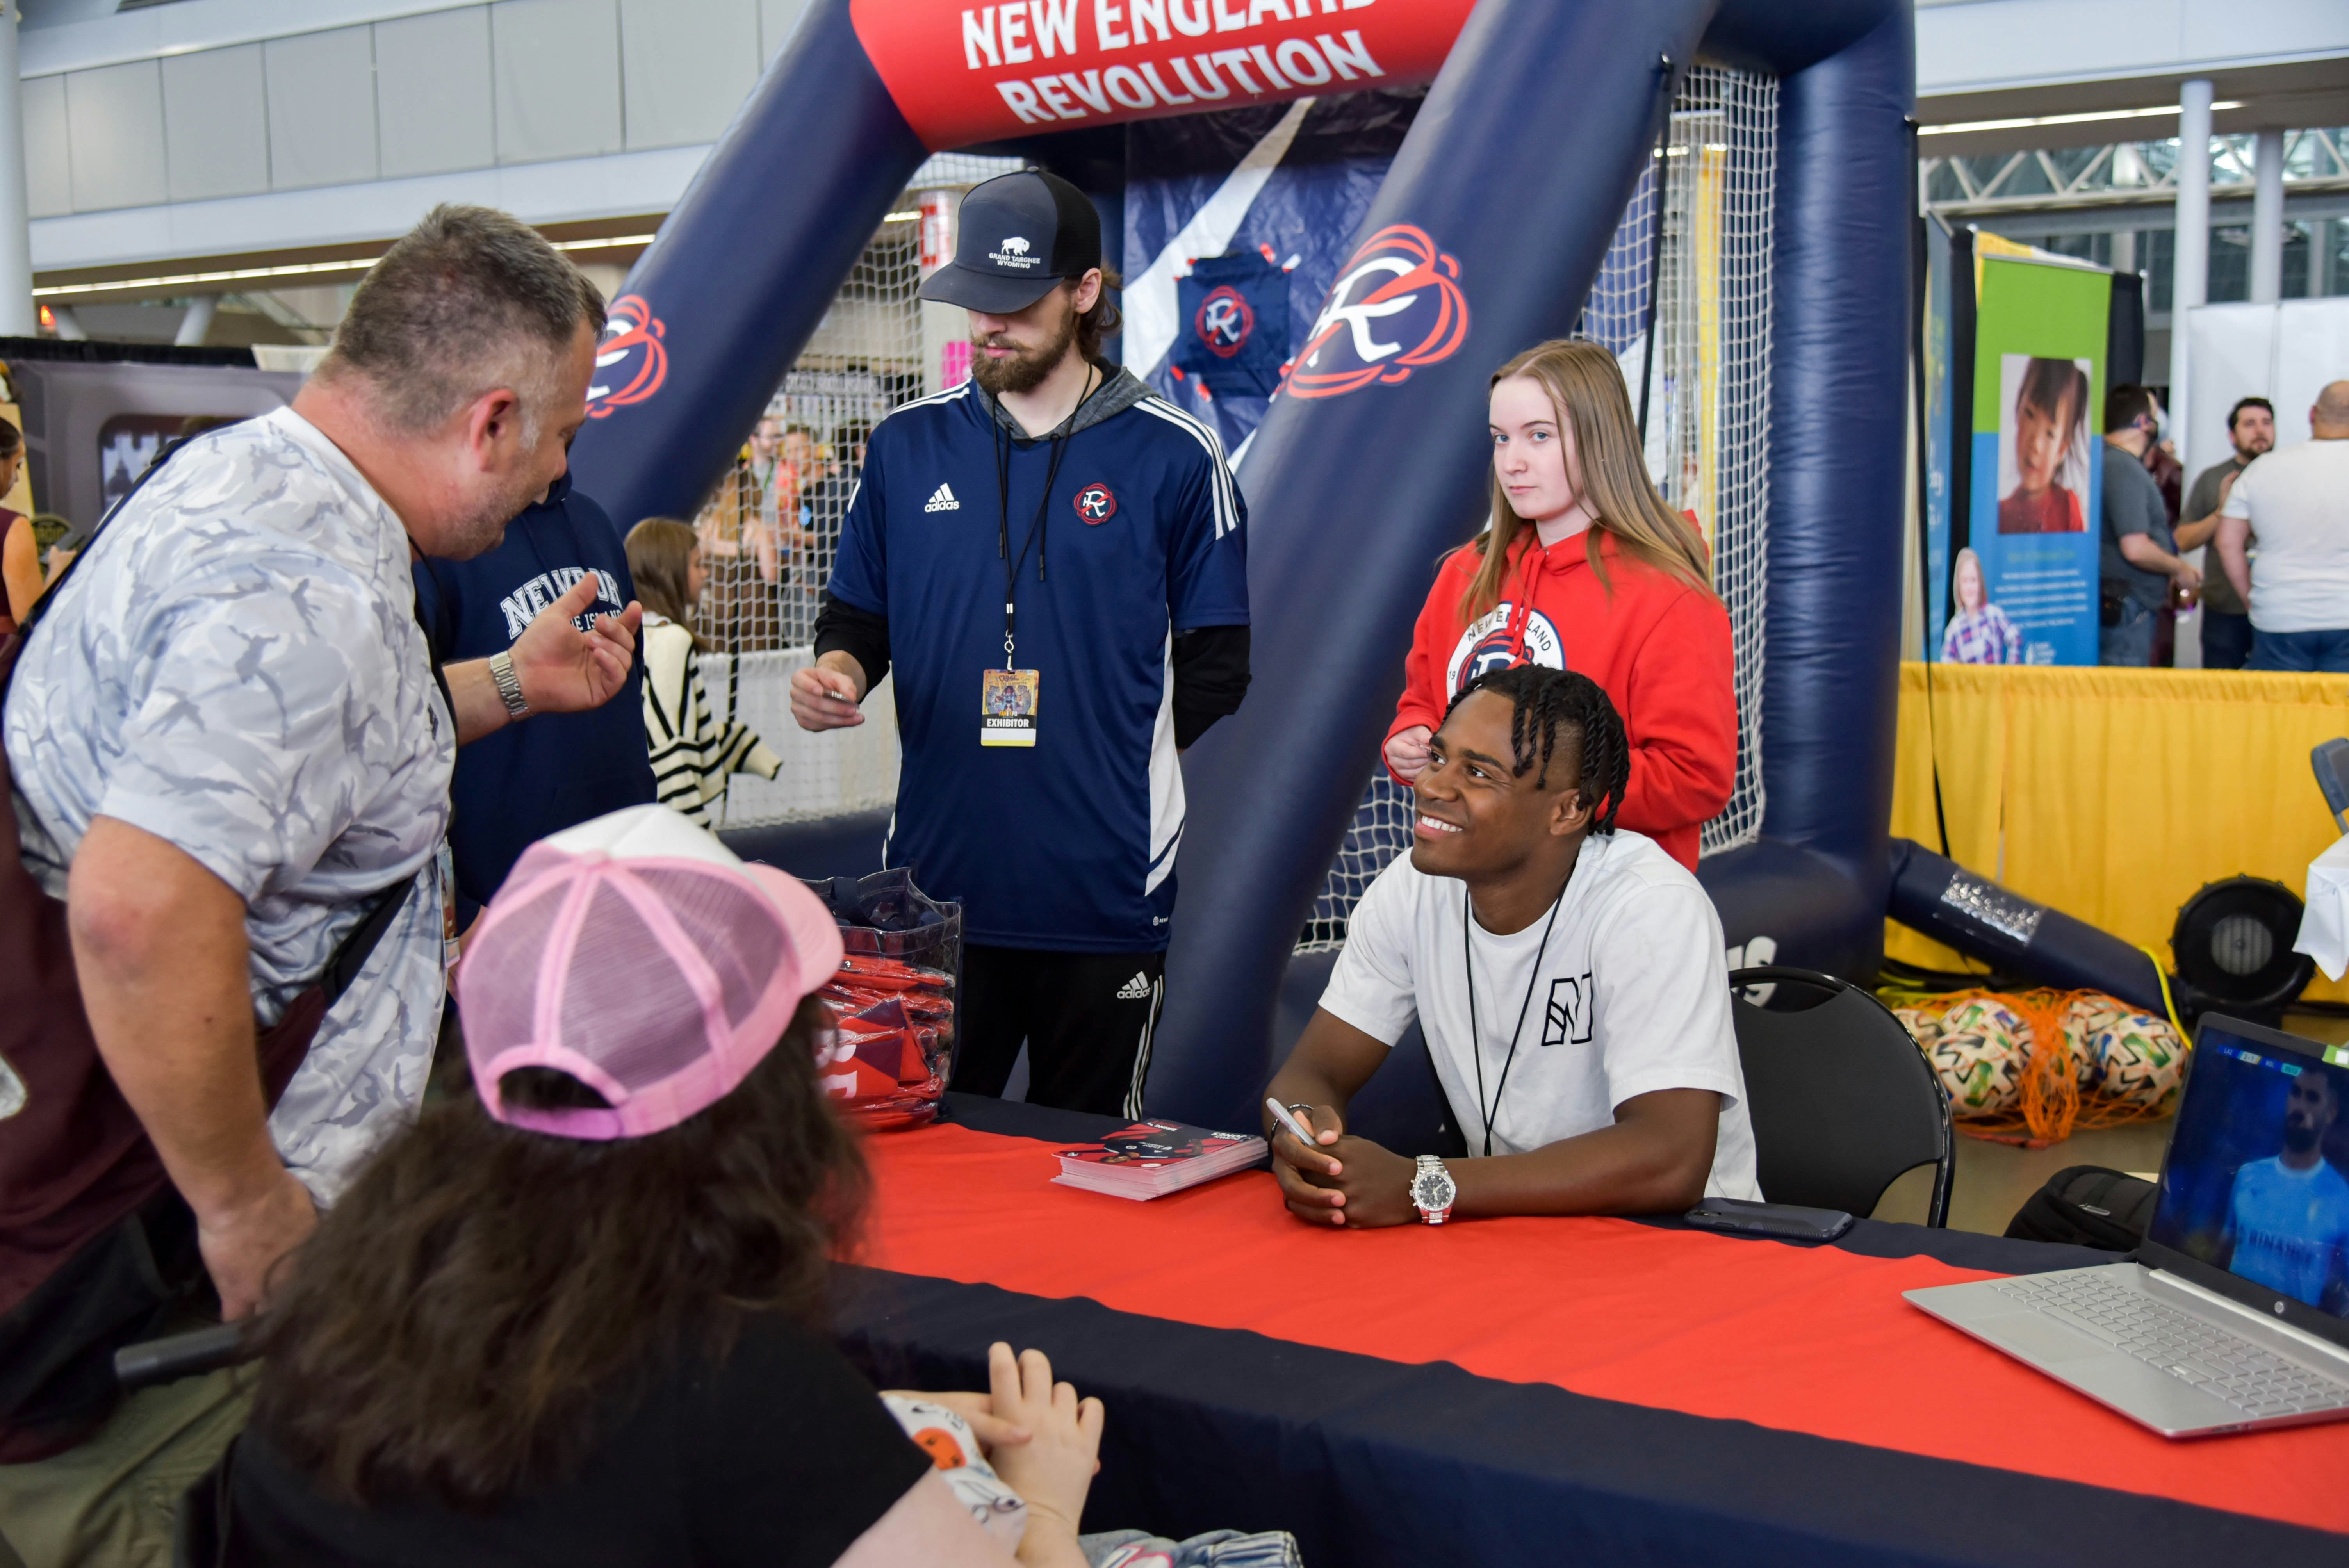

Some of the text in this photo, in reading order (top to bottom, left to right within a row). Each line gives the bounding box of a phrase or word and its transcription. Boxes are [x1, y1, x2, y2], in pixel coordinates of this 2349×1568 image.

[961, 0, 1376, 69] NEW ENGL
[995, 29, 1385, 124] REVOLUTION
[989, 253, 1041, 264] GRAND TARGHEE
[997, 260, 1030, 269] WYOMING
[925, 500, 959, 513] adidas
[1496, 611, 1551, 651] ELAND
[987, 718, 1029, 728] EXHIBITOR
[1117, 987, 1150, 999] adidas
